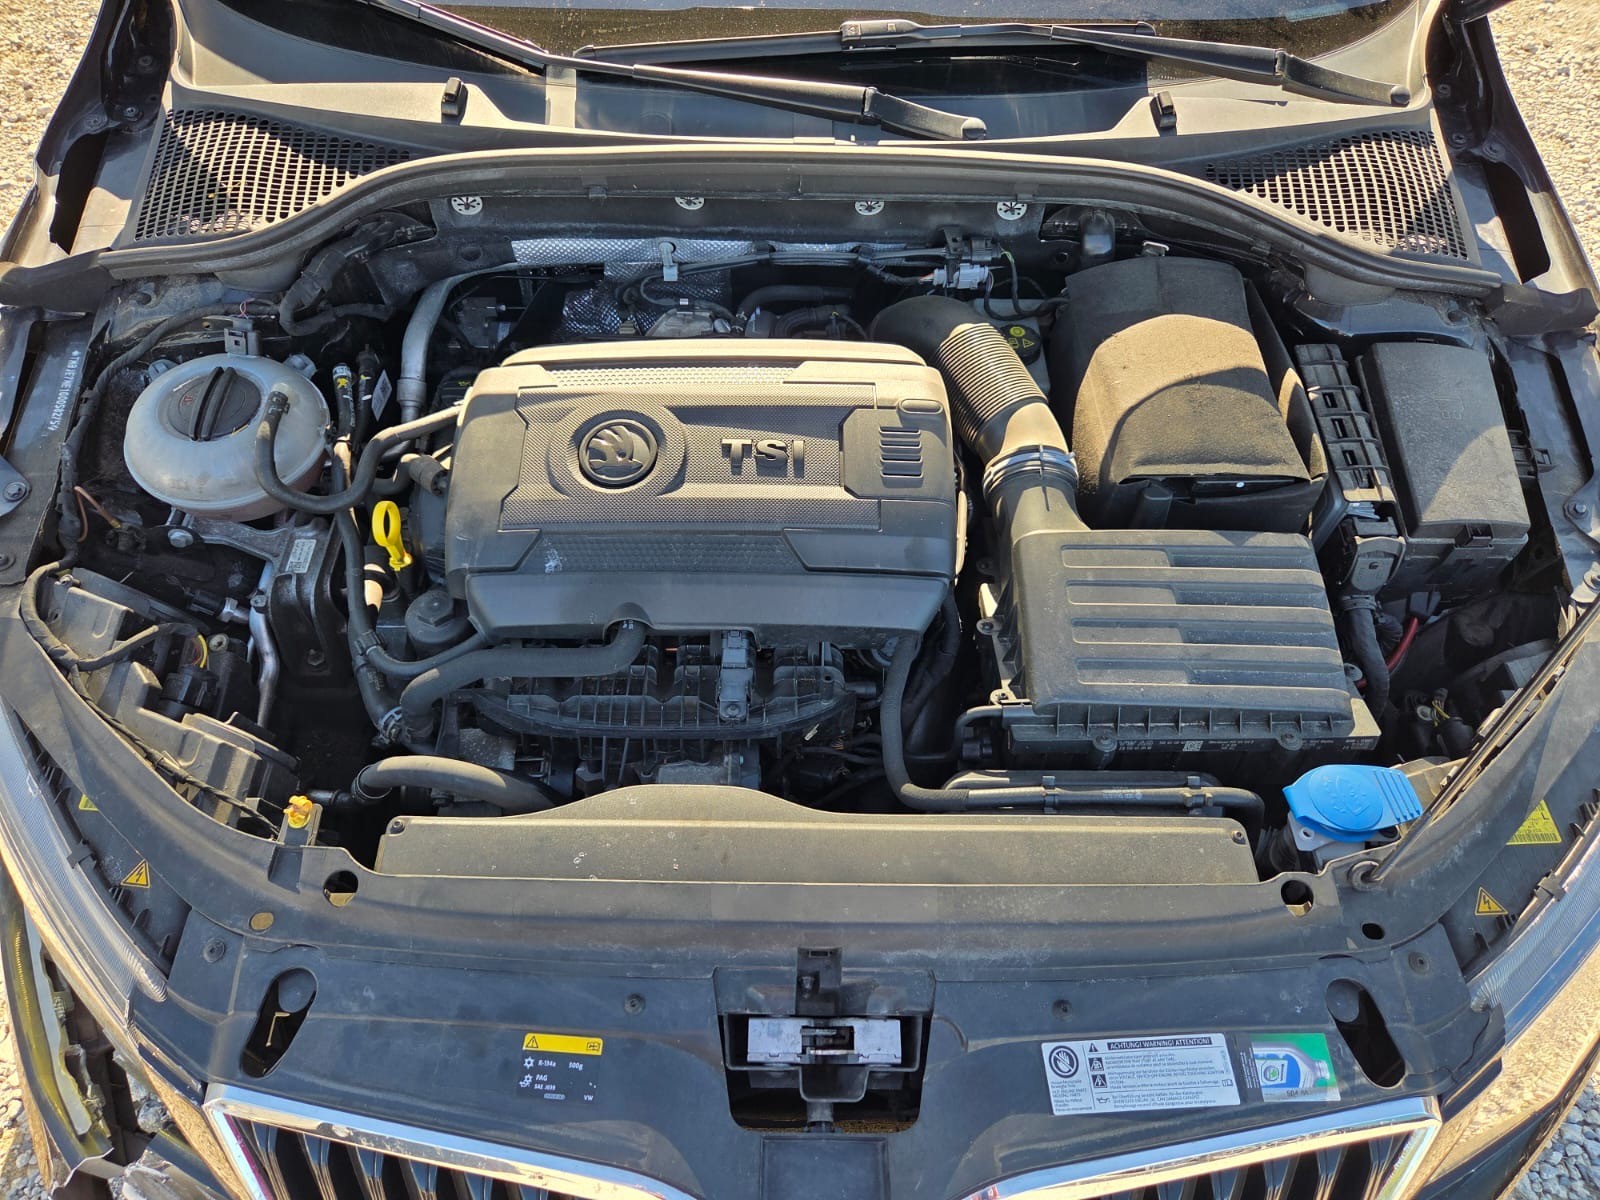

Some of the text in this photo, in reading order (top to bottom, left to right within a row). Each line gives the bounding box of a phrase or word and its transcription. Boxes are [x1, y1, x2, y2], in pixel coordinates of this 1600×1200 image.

[720, 439, 806, 476] TSI
[1110, 1037, 1210, 1050] ACHTUNG! WARNING! ATTENTION!
